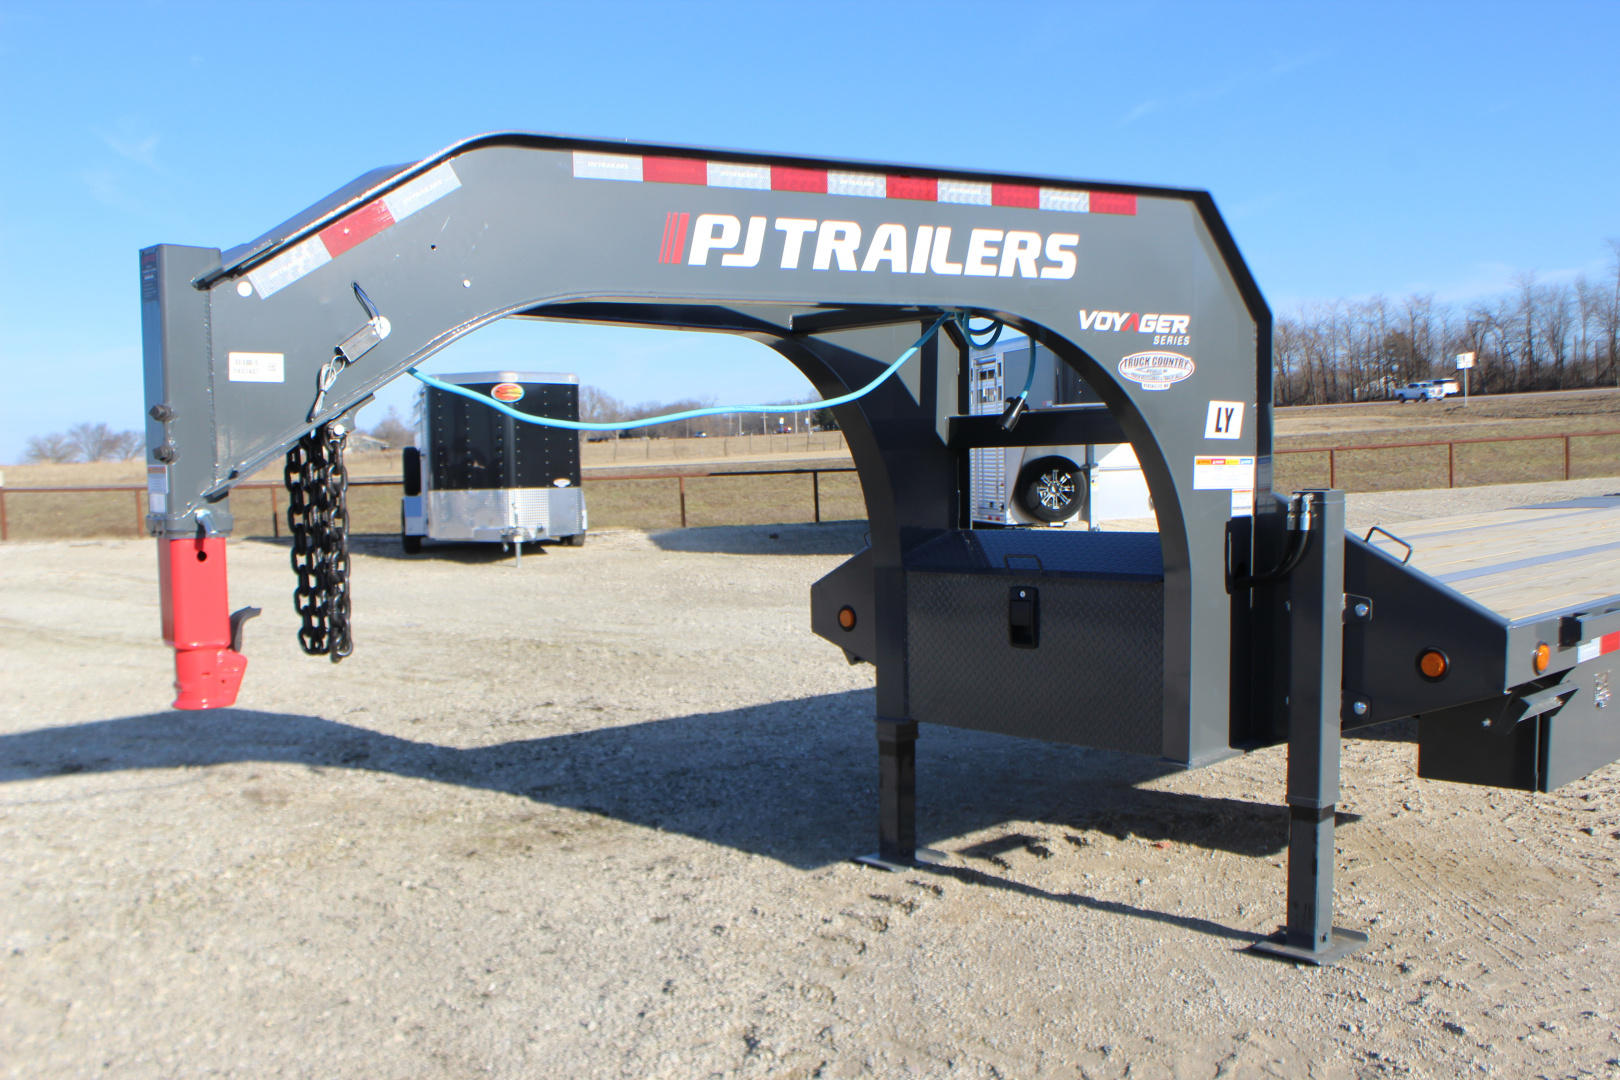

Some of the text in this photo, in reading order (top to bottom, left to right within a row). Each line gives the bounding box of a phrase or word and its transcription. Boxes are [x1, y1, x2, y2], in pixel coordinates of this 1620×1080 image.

[687, 213, 1080, 280] PJ TRAILERS
[1079, 309, 1191, 334] VOYAGER
[1153, 335, 1191, 346] SERIES
[1123, 356, 1189, 369] TRUCK COUNTRY
[1214, 407, 1235, 434] LY
